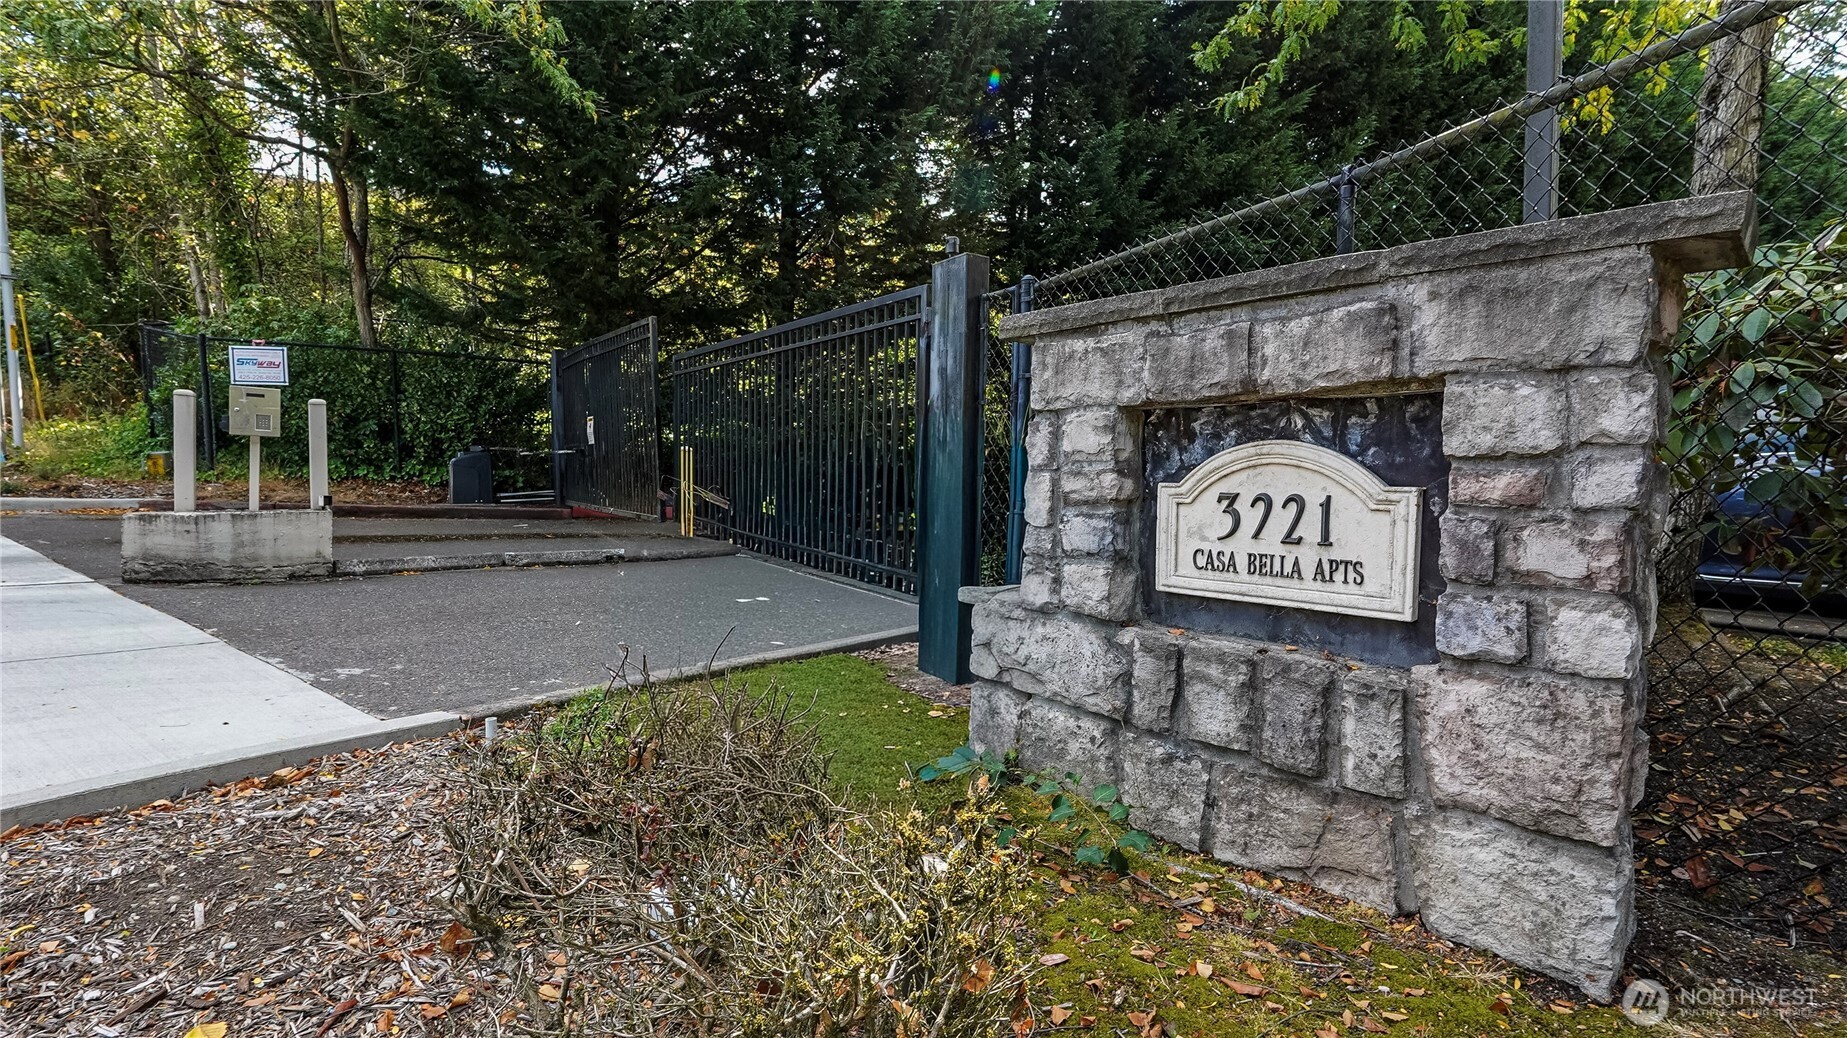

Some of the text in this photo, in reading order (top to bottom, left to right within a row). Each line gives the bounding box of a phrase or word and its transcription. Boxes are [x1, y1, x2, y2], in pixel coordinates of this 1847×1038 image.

[1192, 548, 1364, 585] CASA BELLA APTS
